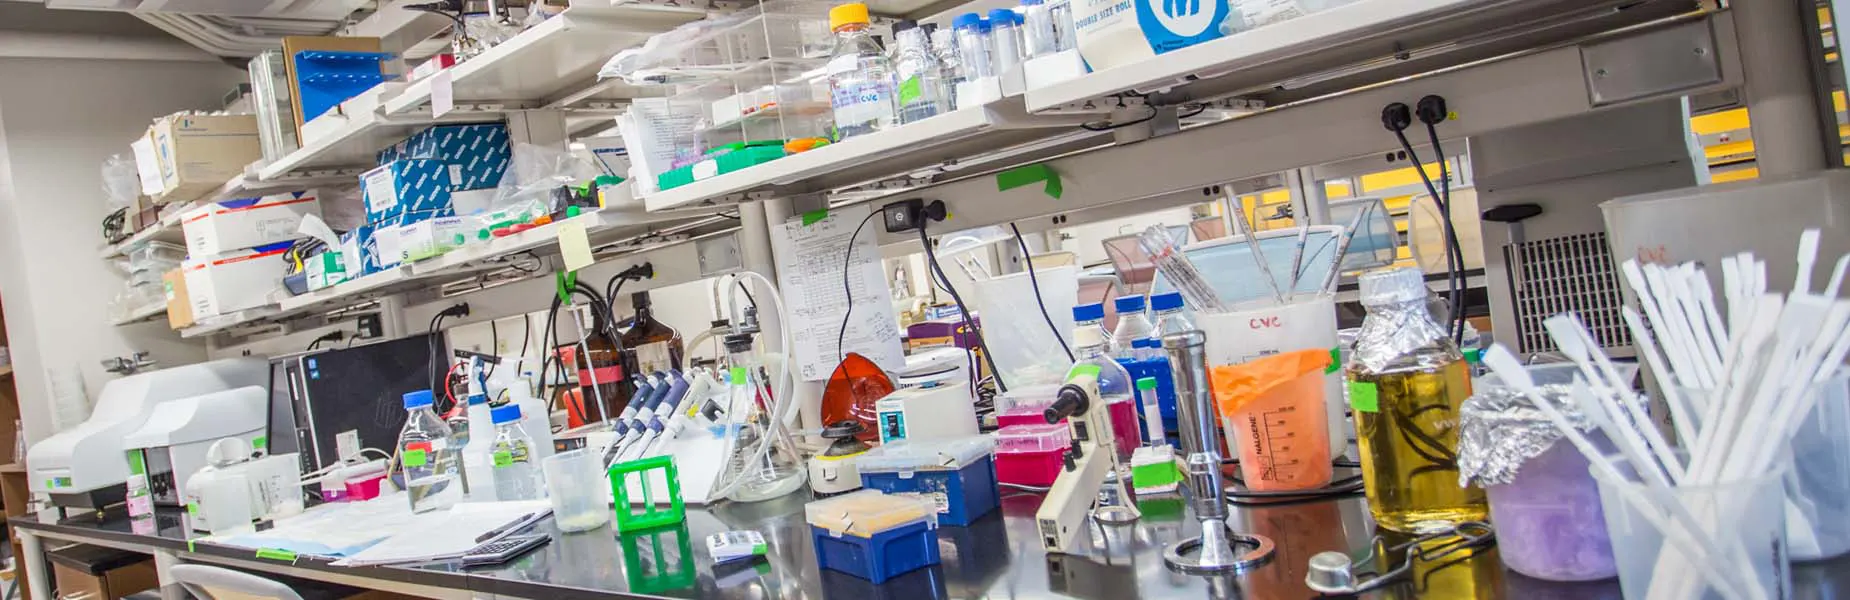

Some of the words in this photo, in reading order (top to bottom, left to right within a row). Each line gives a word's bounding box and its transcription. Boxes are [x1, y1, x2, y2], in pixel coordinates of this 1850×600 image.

[1076, 14, 1098, 30] DOUBLE
[1099, 6, 1113, 20] SIZE
[1115, 0, 1132, 13] ROLL
[1249, 316, 1281, 329] CVC
[1248, 416, 1262, 455] NALGENE
